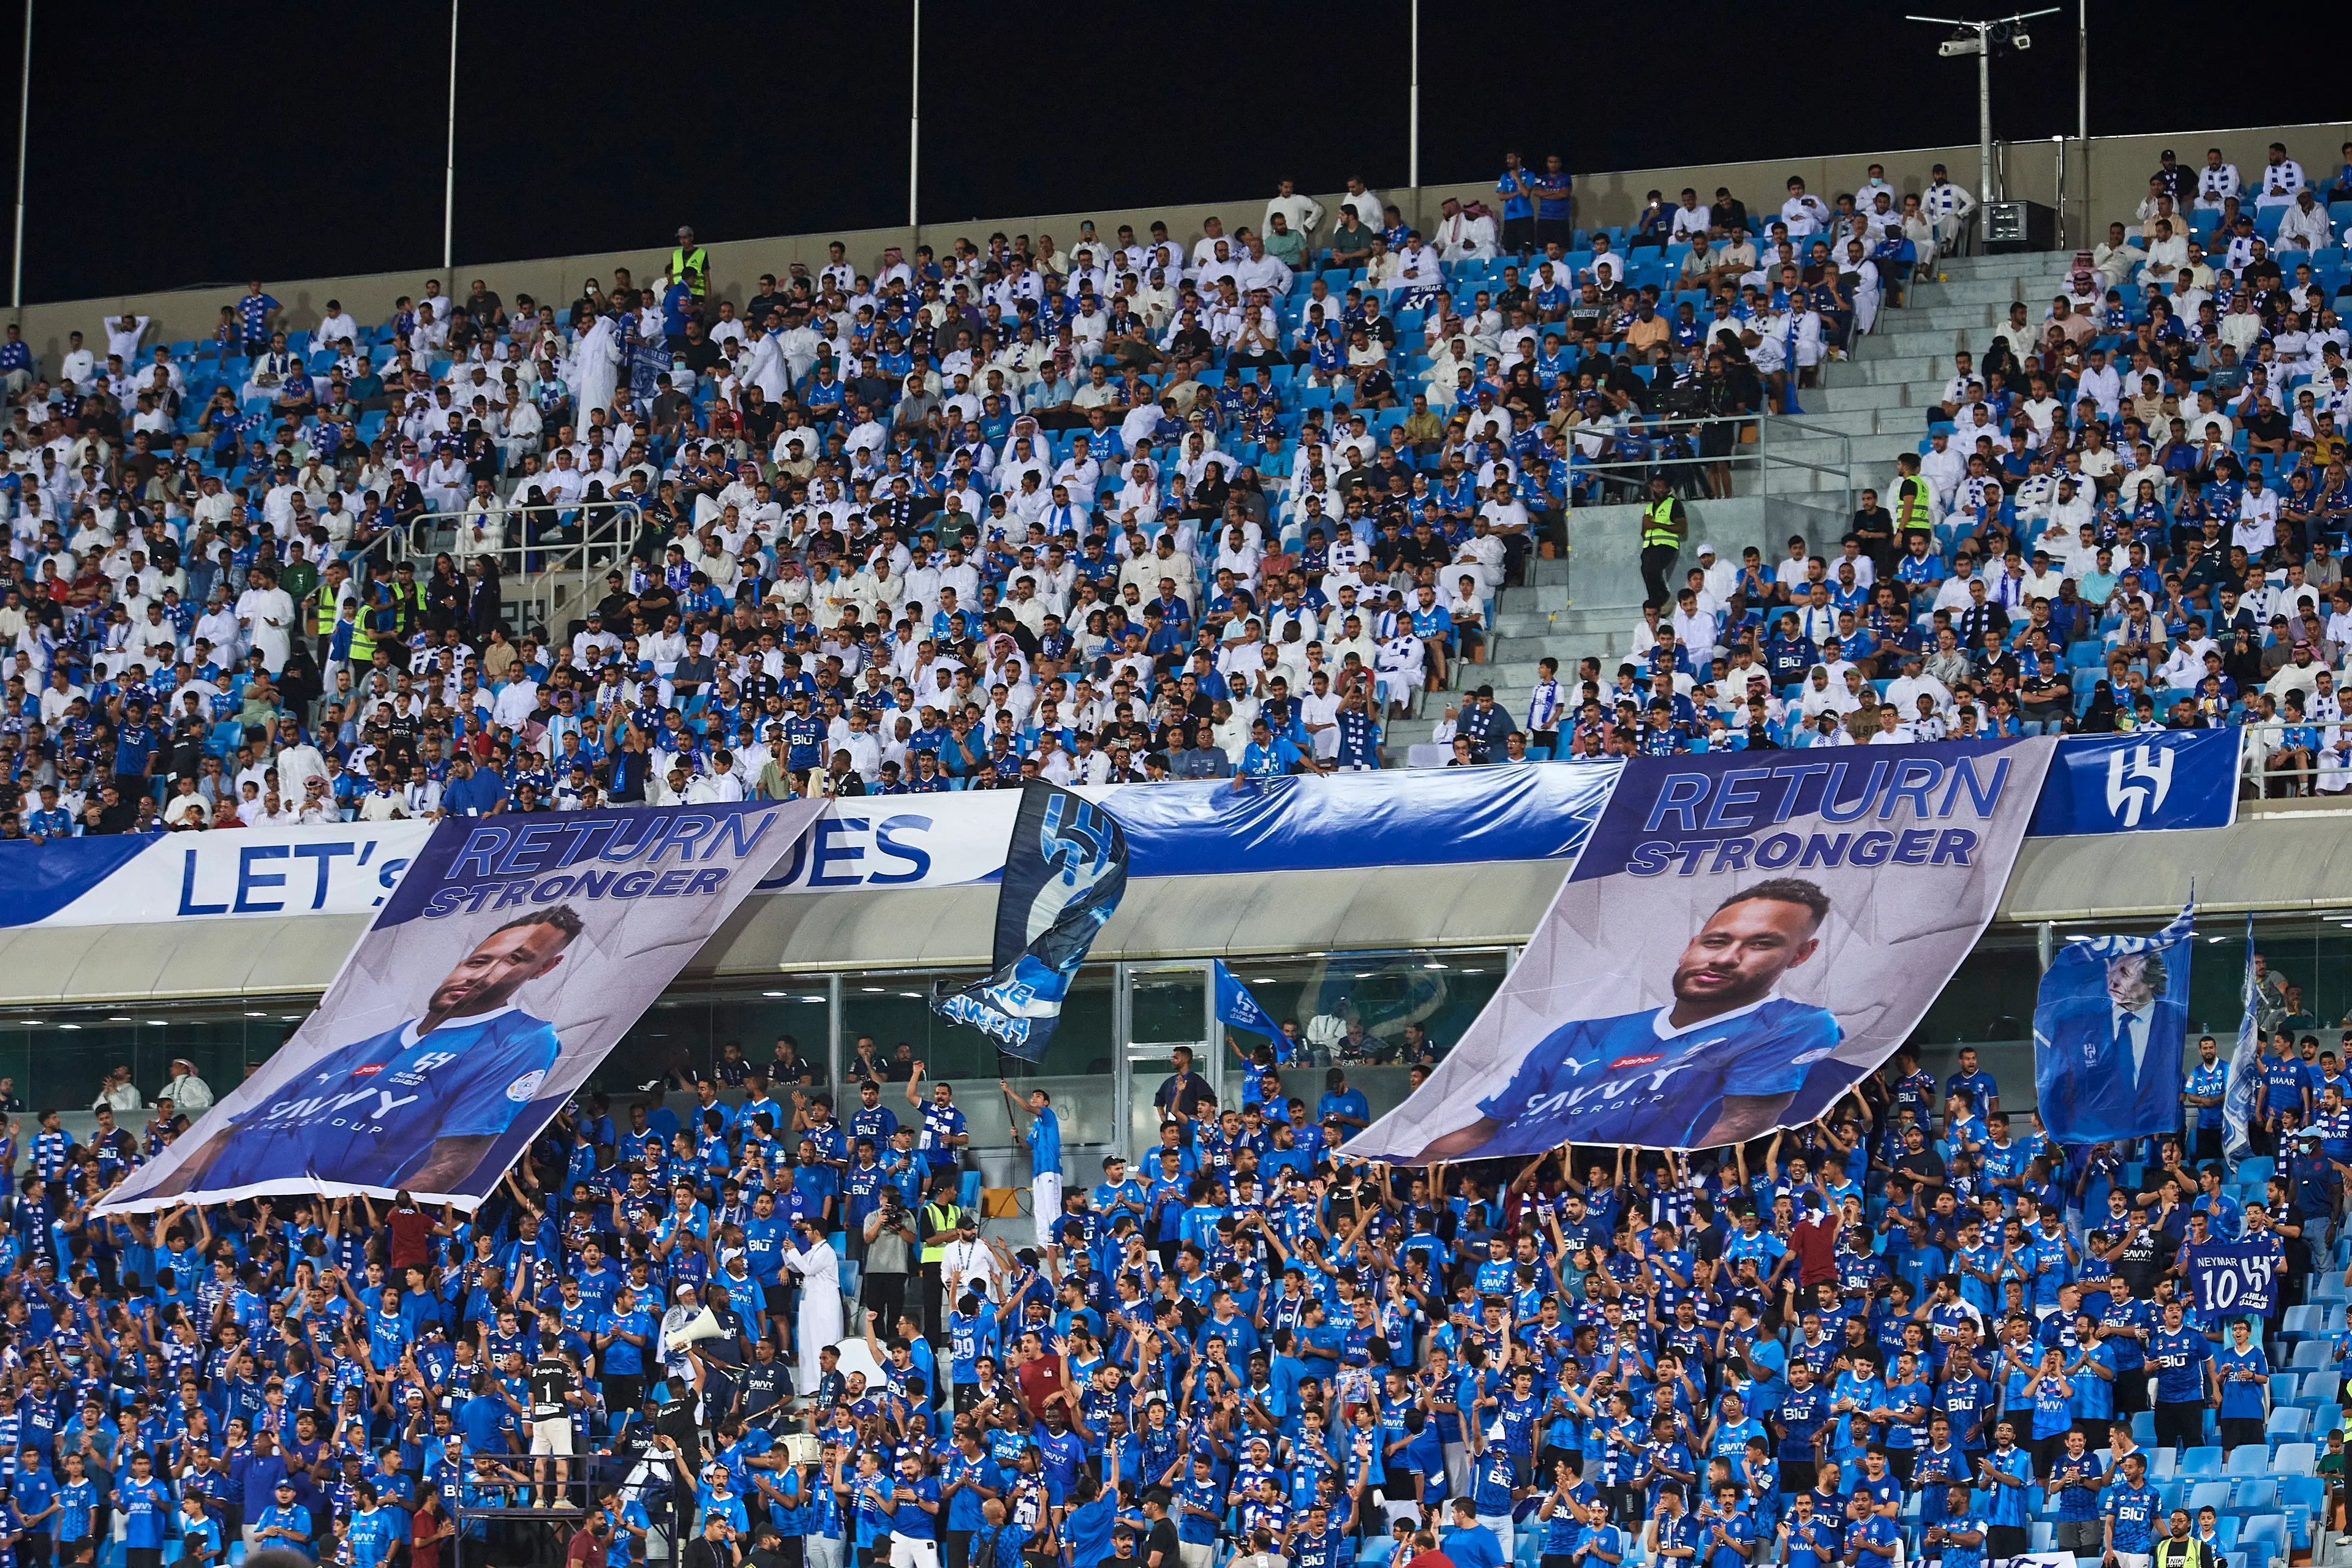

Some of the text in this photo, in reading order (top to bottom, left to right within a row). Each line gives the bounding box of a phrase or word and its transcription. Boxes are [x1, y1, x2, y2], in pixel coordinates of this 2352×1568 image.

[1411, 285, 1442, 293] NEYMAR
[1779, 657, 1801, 668] Blu
[792, 734, 813, 746] Blu
[1643, 756, 2011, 832] RETURN
[445, 812, 778, 880] RETURN
[1626, 829, 1979, 876] STRONGER
[423, 867, 730, 918] STRONGER
[1521, 1064, 1694, 1117] SAVVY
[2197, 1082, 2223, 1095] SAVVY
[1899, 1092, 1916, 1102] Blu
[260, 1087, 419, 1120] SAVVY
[1570, 1094, 1665, 1115] GROUP
[856, 1125, 876, 1135] Blu
[1986, 1159, 2010, 1173] SAVVY
[852, 1185, 869, 1196] Blu
[1202, 1224, 1219, 1248] 10
[749, 1240, 770, 1251] Blu
[1564, 1239, 1585, 1250] Blu
[2041, 1254, 2064, 1263] SAVVY
[2123, 1249, 2154, 1258] SAVVY
[2197, 1257, 2239, 1267] NEYMAR
[1482, 1278, 1507, 1288] SAVVY
[1848, 1276, 1869, 1288] Blu
[579, 1291, 602, 1299] EMAAR
[729, 1289, 752, 1303] SAVVY
[2203, 1269, 2238, 1311] 10
[2240, 1292, 2269, 1302] ALHILAL
[1330, 1316, 1357, 1326] SAVVY
[2159, 1355, 2185, 1368] Blu
[543, 1382, 551, 1403] 1
[888, 1381, 907, 1398] Blu
[1849, 1396, 1870, 1408] AVVY
[1948, 1398, 1973, 1412] Blu
[1506, 1411, 1521, 1422] Blu
[1784, 1408, 1809, 1420] Blu
[32, 1414, 54, 1429] Blu
[995, 1444, 1022, 1457] SAVVY
[1719, 1442, 1746, 1453] SAVVY
[1488, 1470, 1511, 1488] Blu
[2119, 1506, 2144, 1521] Blu
[1302, 1555, 1325, 1567] Blu
